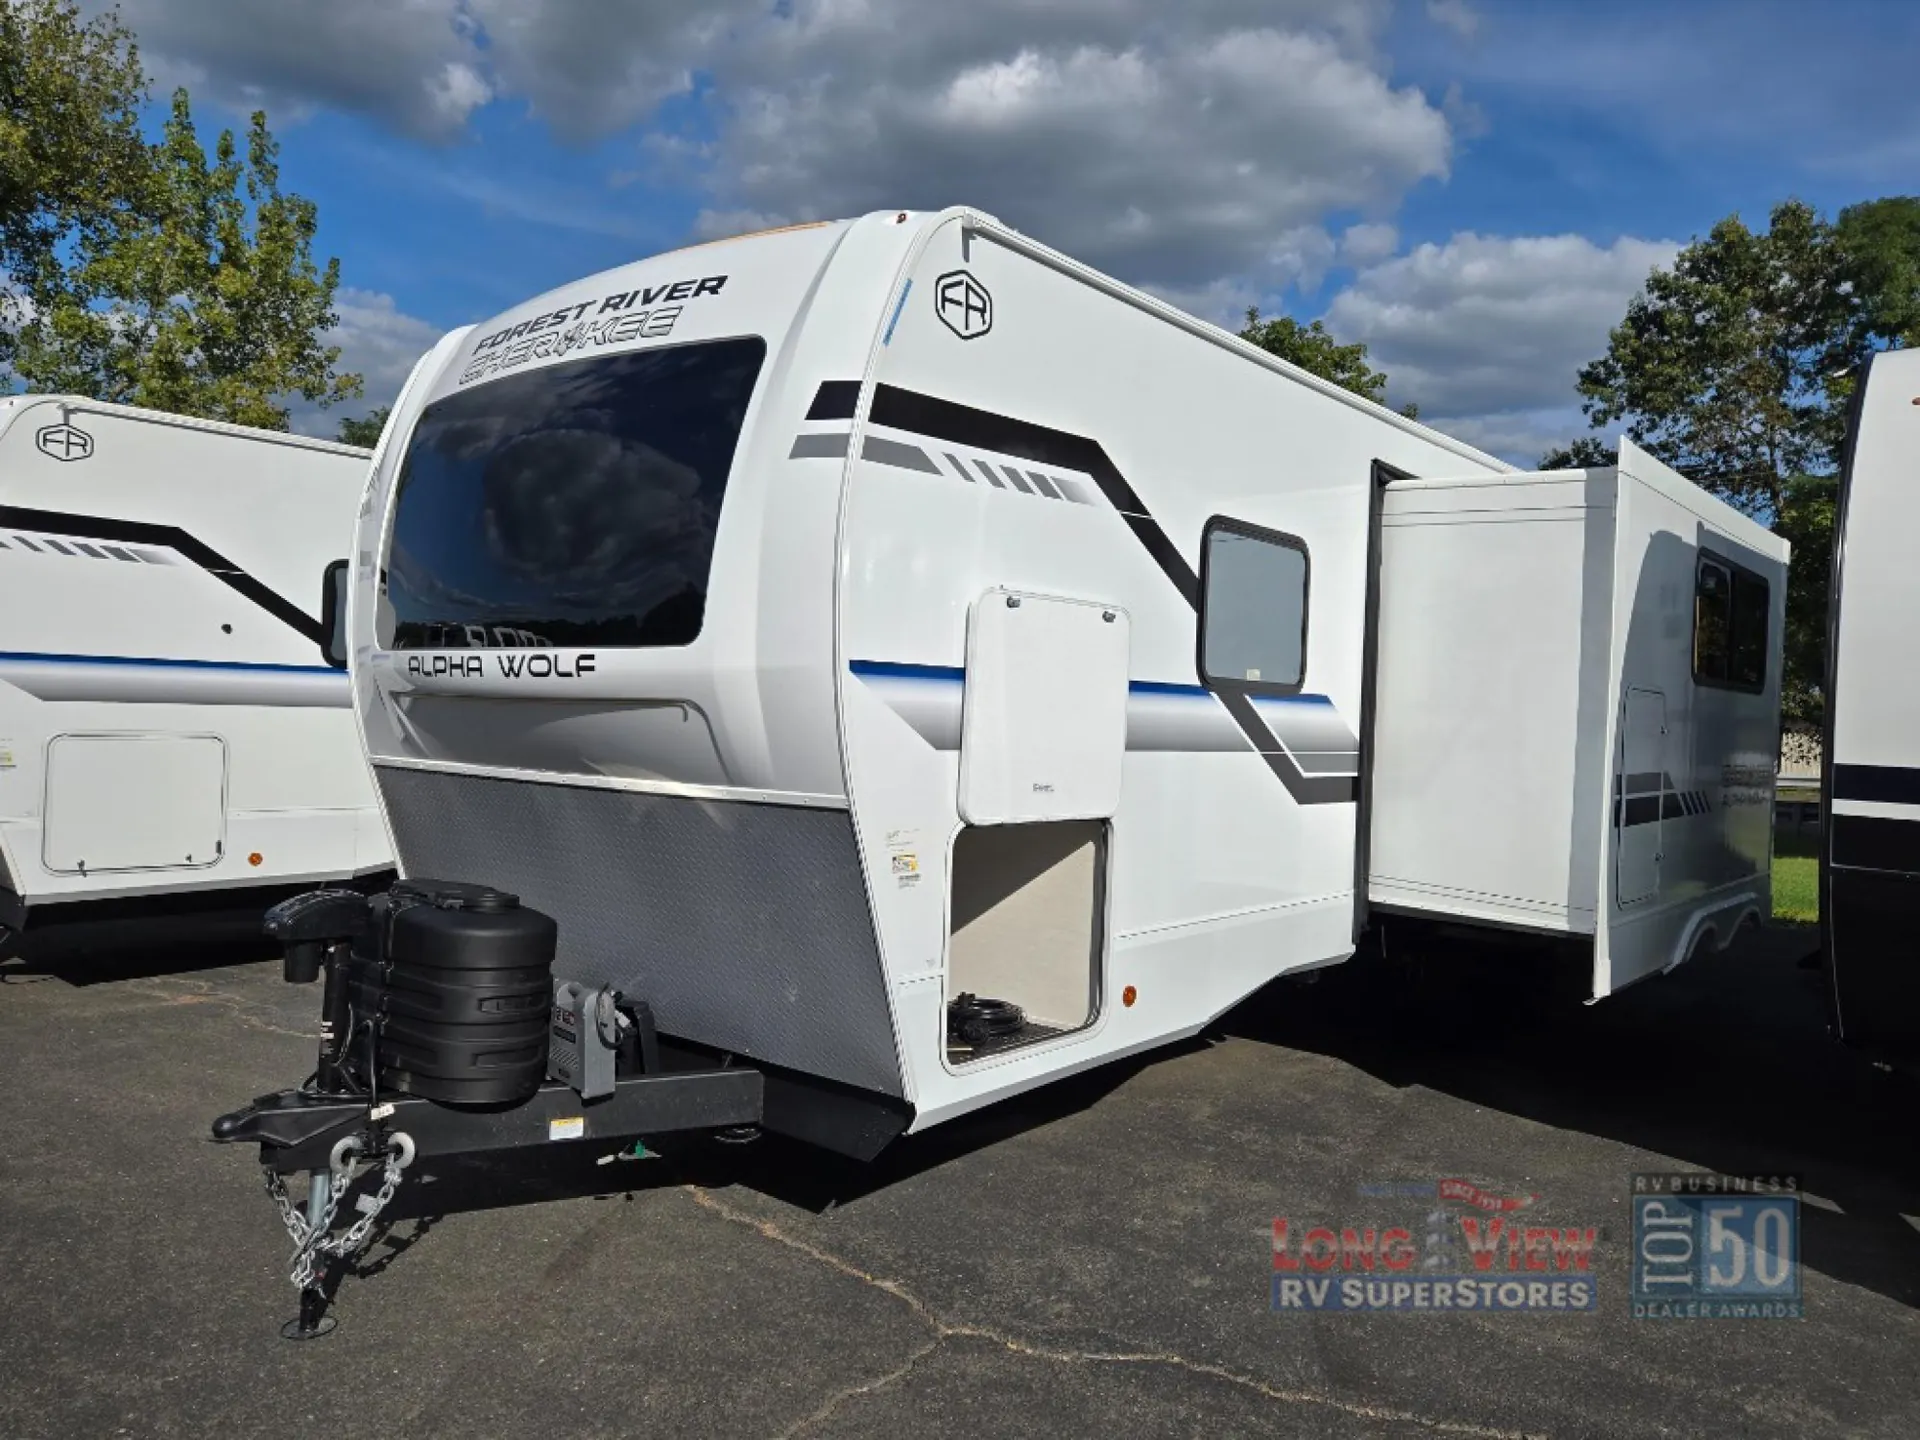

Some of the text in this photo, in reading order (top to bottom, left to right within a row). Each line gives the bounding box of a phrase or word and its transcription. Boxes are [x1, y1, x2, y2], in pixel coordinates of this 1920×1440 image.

[472, 274, 729, 355] FOREST RIVER
[408, 654, 596, 678] ALPHA WOLF
